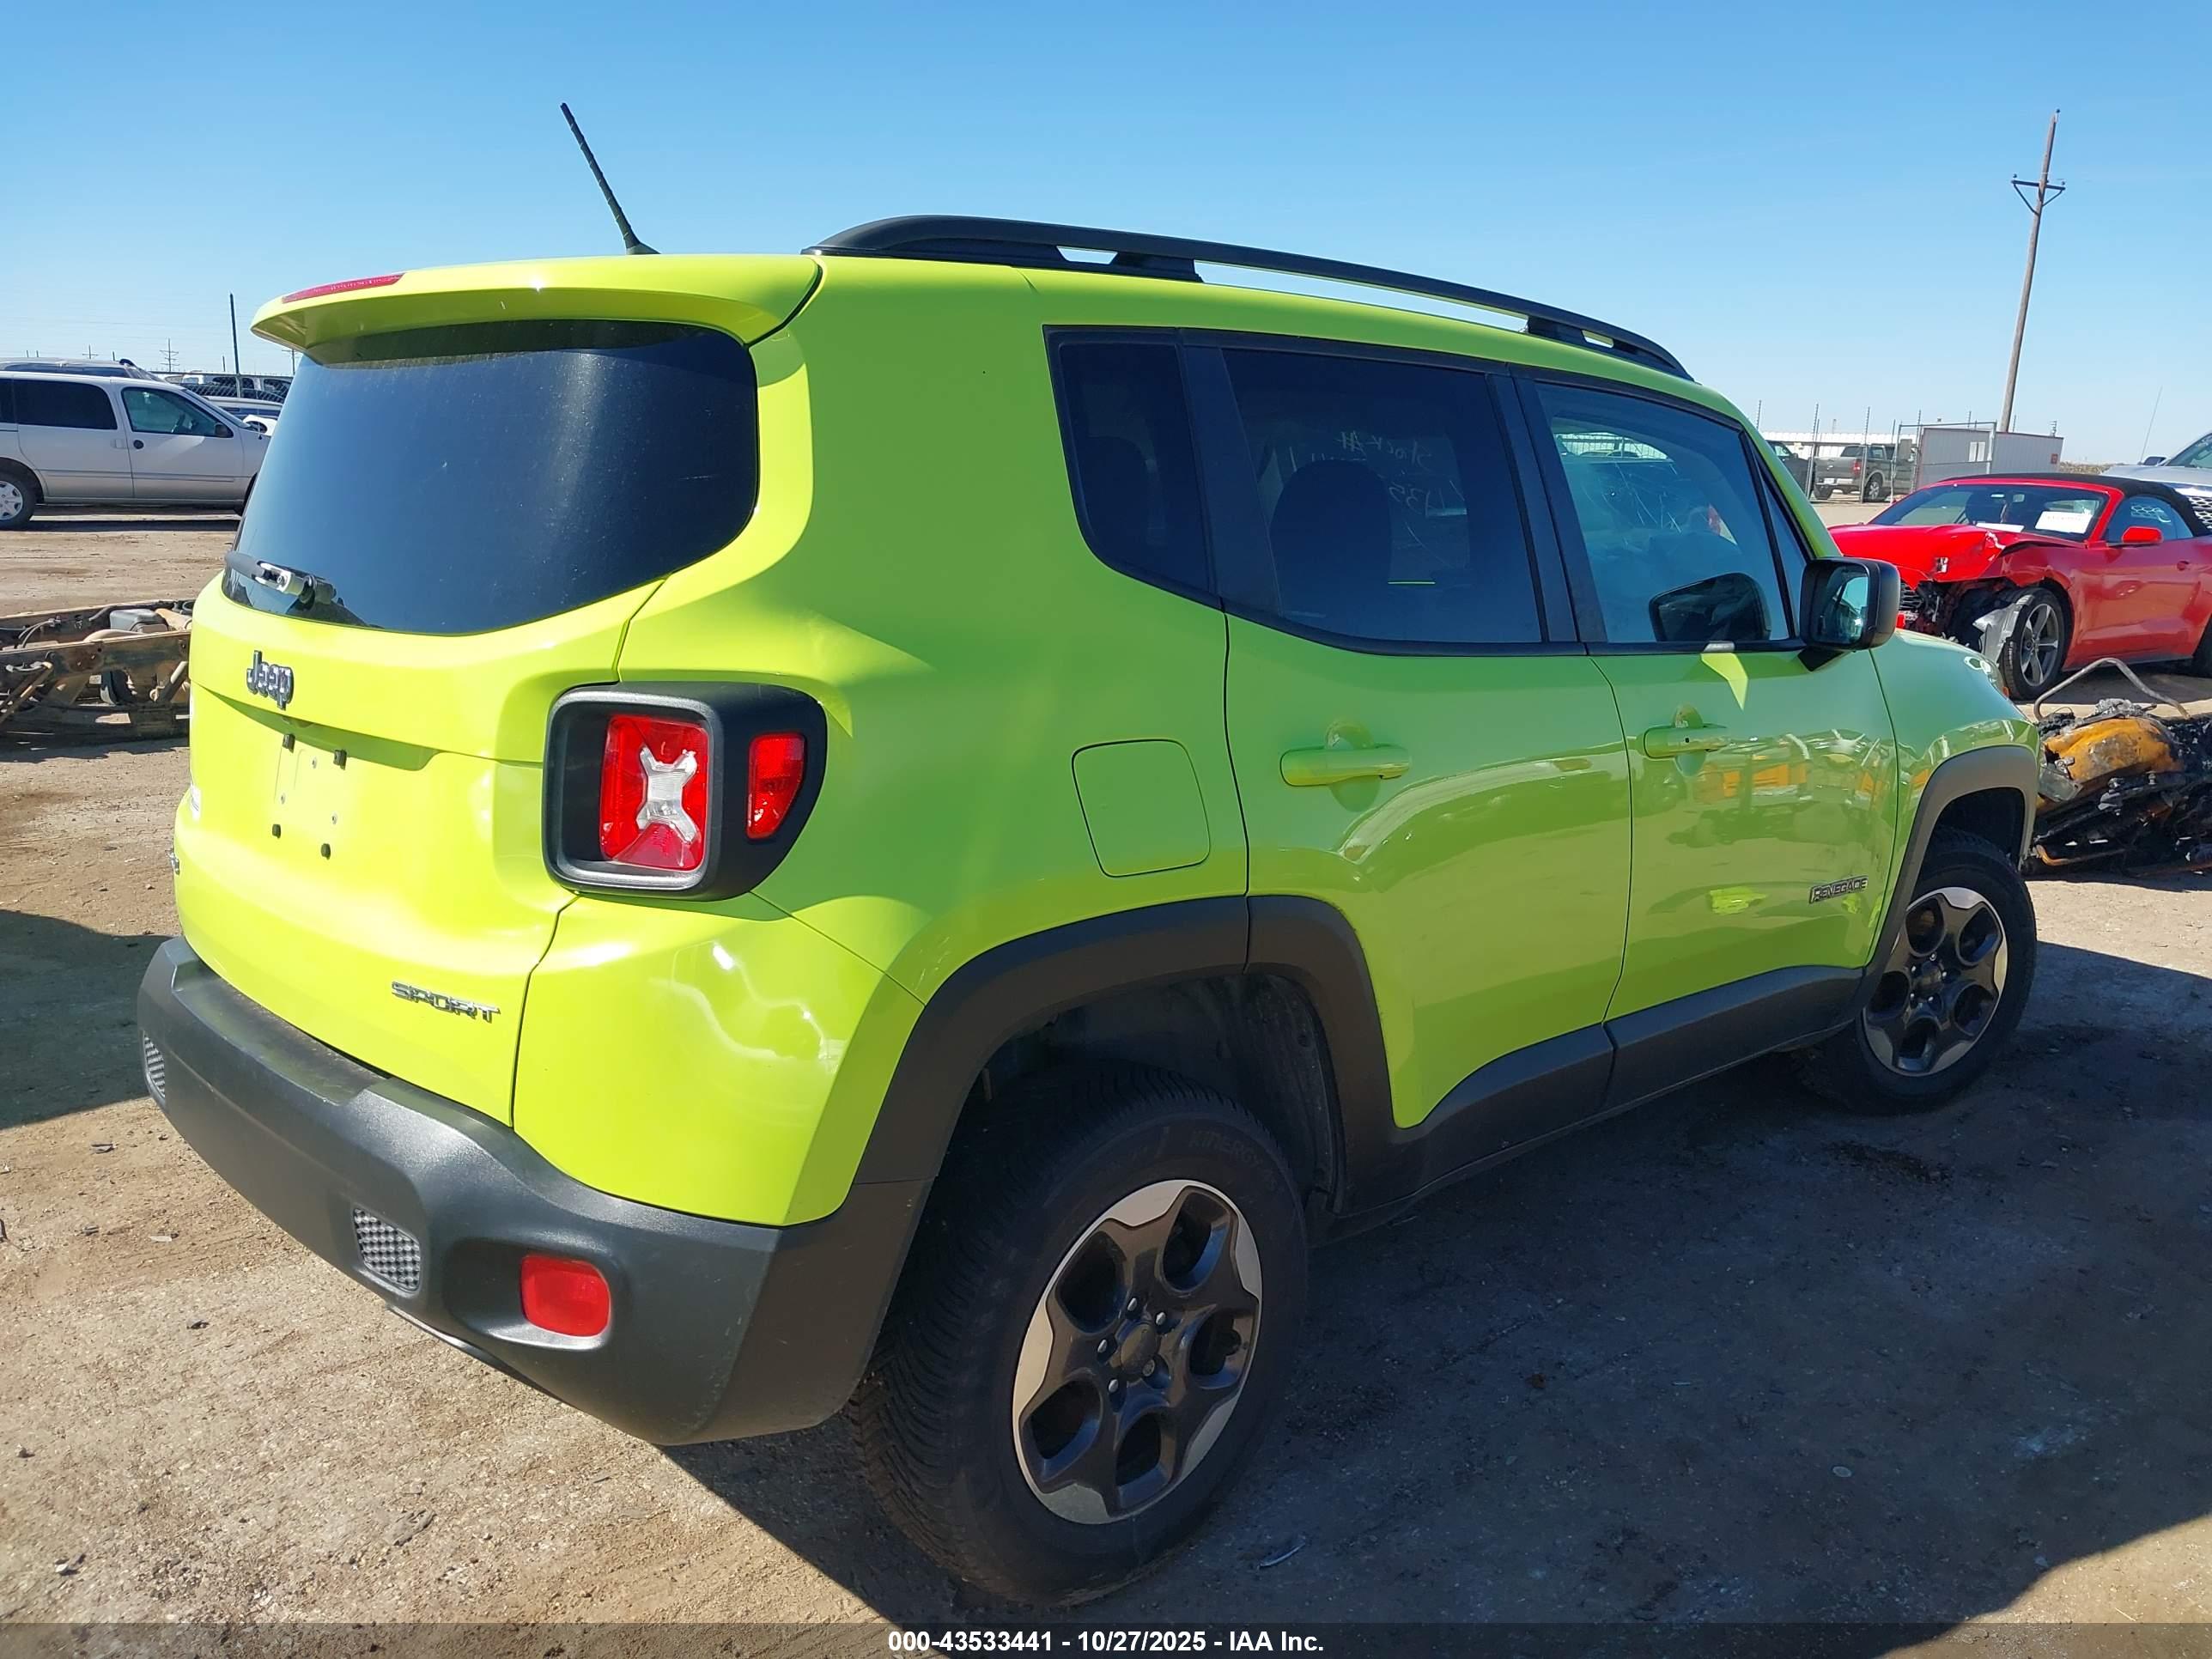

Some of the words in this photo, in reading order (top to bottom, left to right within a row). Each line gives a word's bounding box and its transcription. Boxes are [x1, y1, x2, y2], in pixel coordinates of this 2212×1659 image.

[246, 650, 294, 711] Jeep
[1809, 875, 1869, 904] RENEGADE
[392, 981, 501, 1024] SPORT
